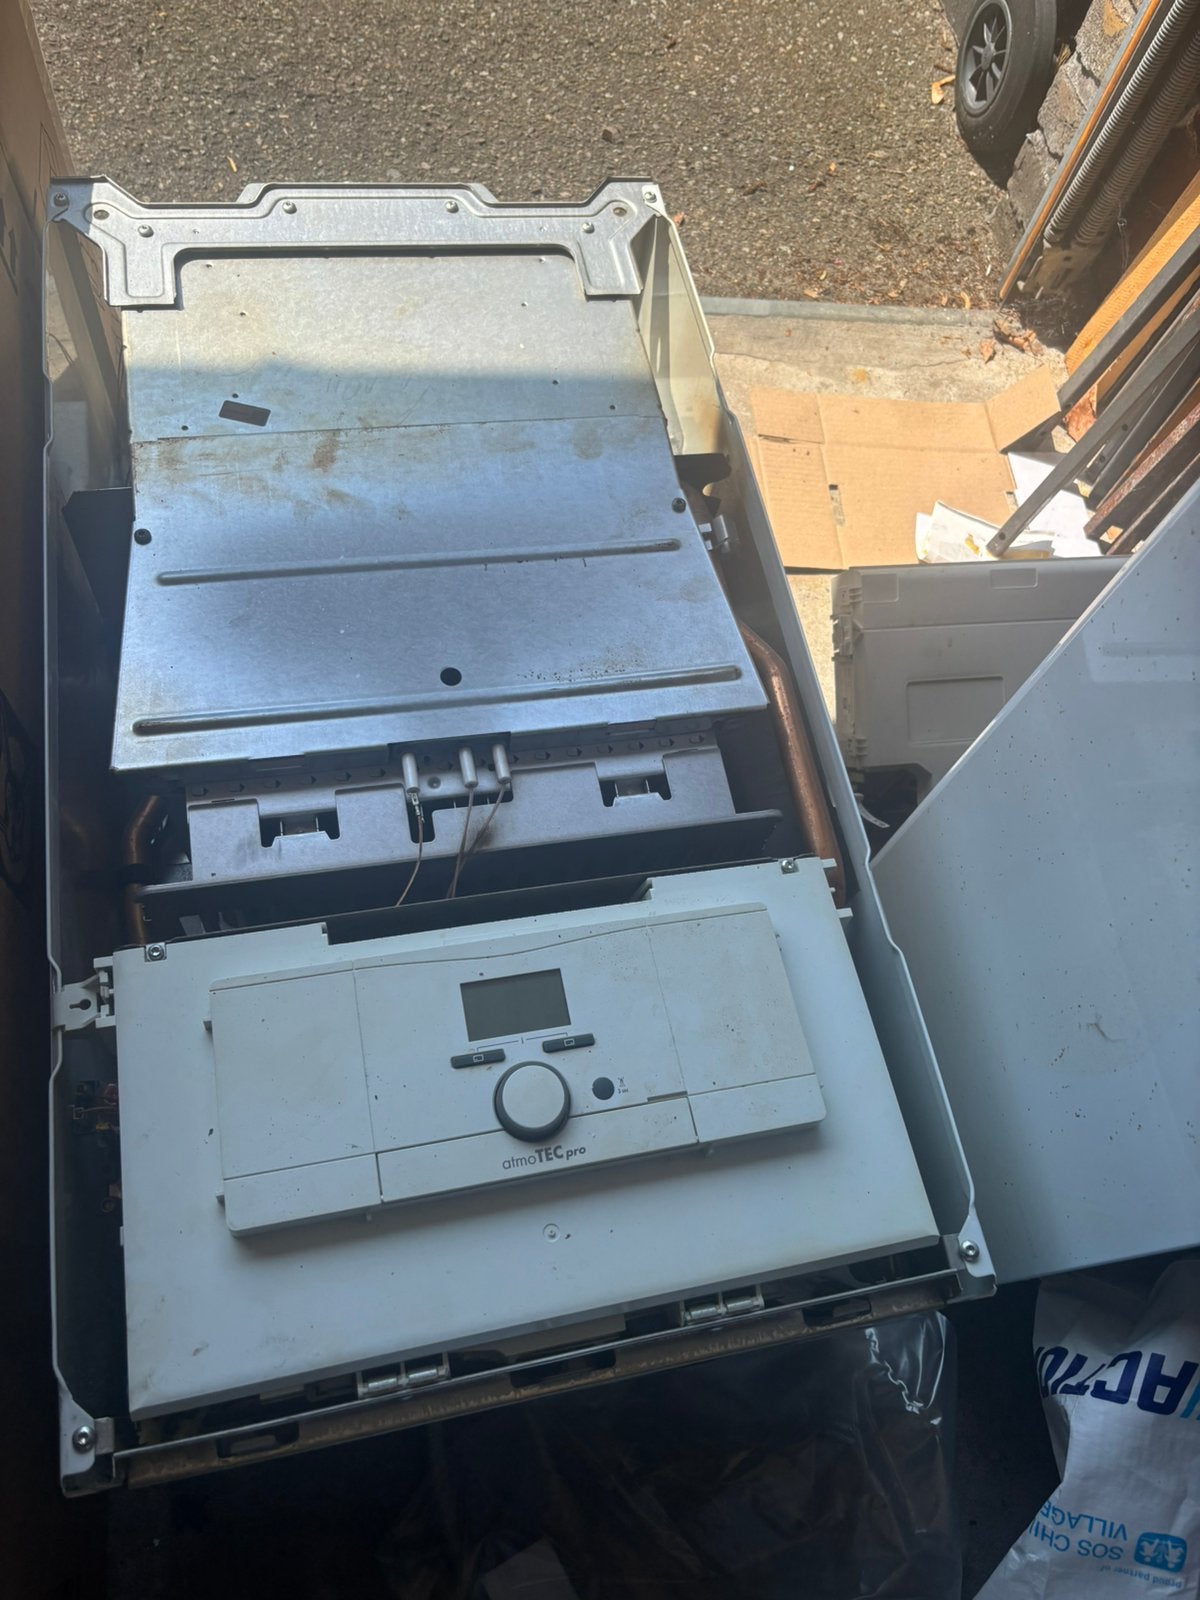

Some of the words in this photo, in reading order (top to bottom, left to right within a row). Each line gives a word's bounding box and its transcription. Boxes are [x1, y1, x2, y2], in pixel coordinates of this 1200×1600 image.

[502, 1145, 564, 1170] atmoTEC
[565, 1146, 586, 1160] pro
[1035, 1346, 1199, 1415] ACTIO
[1077, 1539, 1124, 1560] SOS
[1114, 1567, 1150, 1581] partner
[1152, 1576, 1182, 1589] proud
